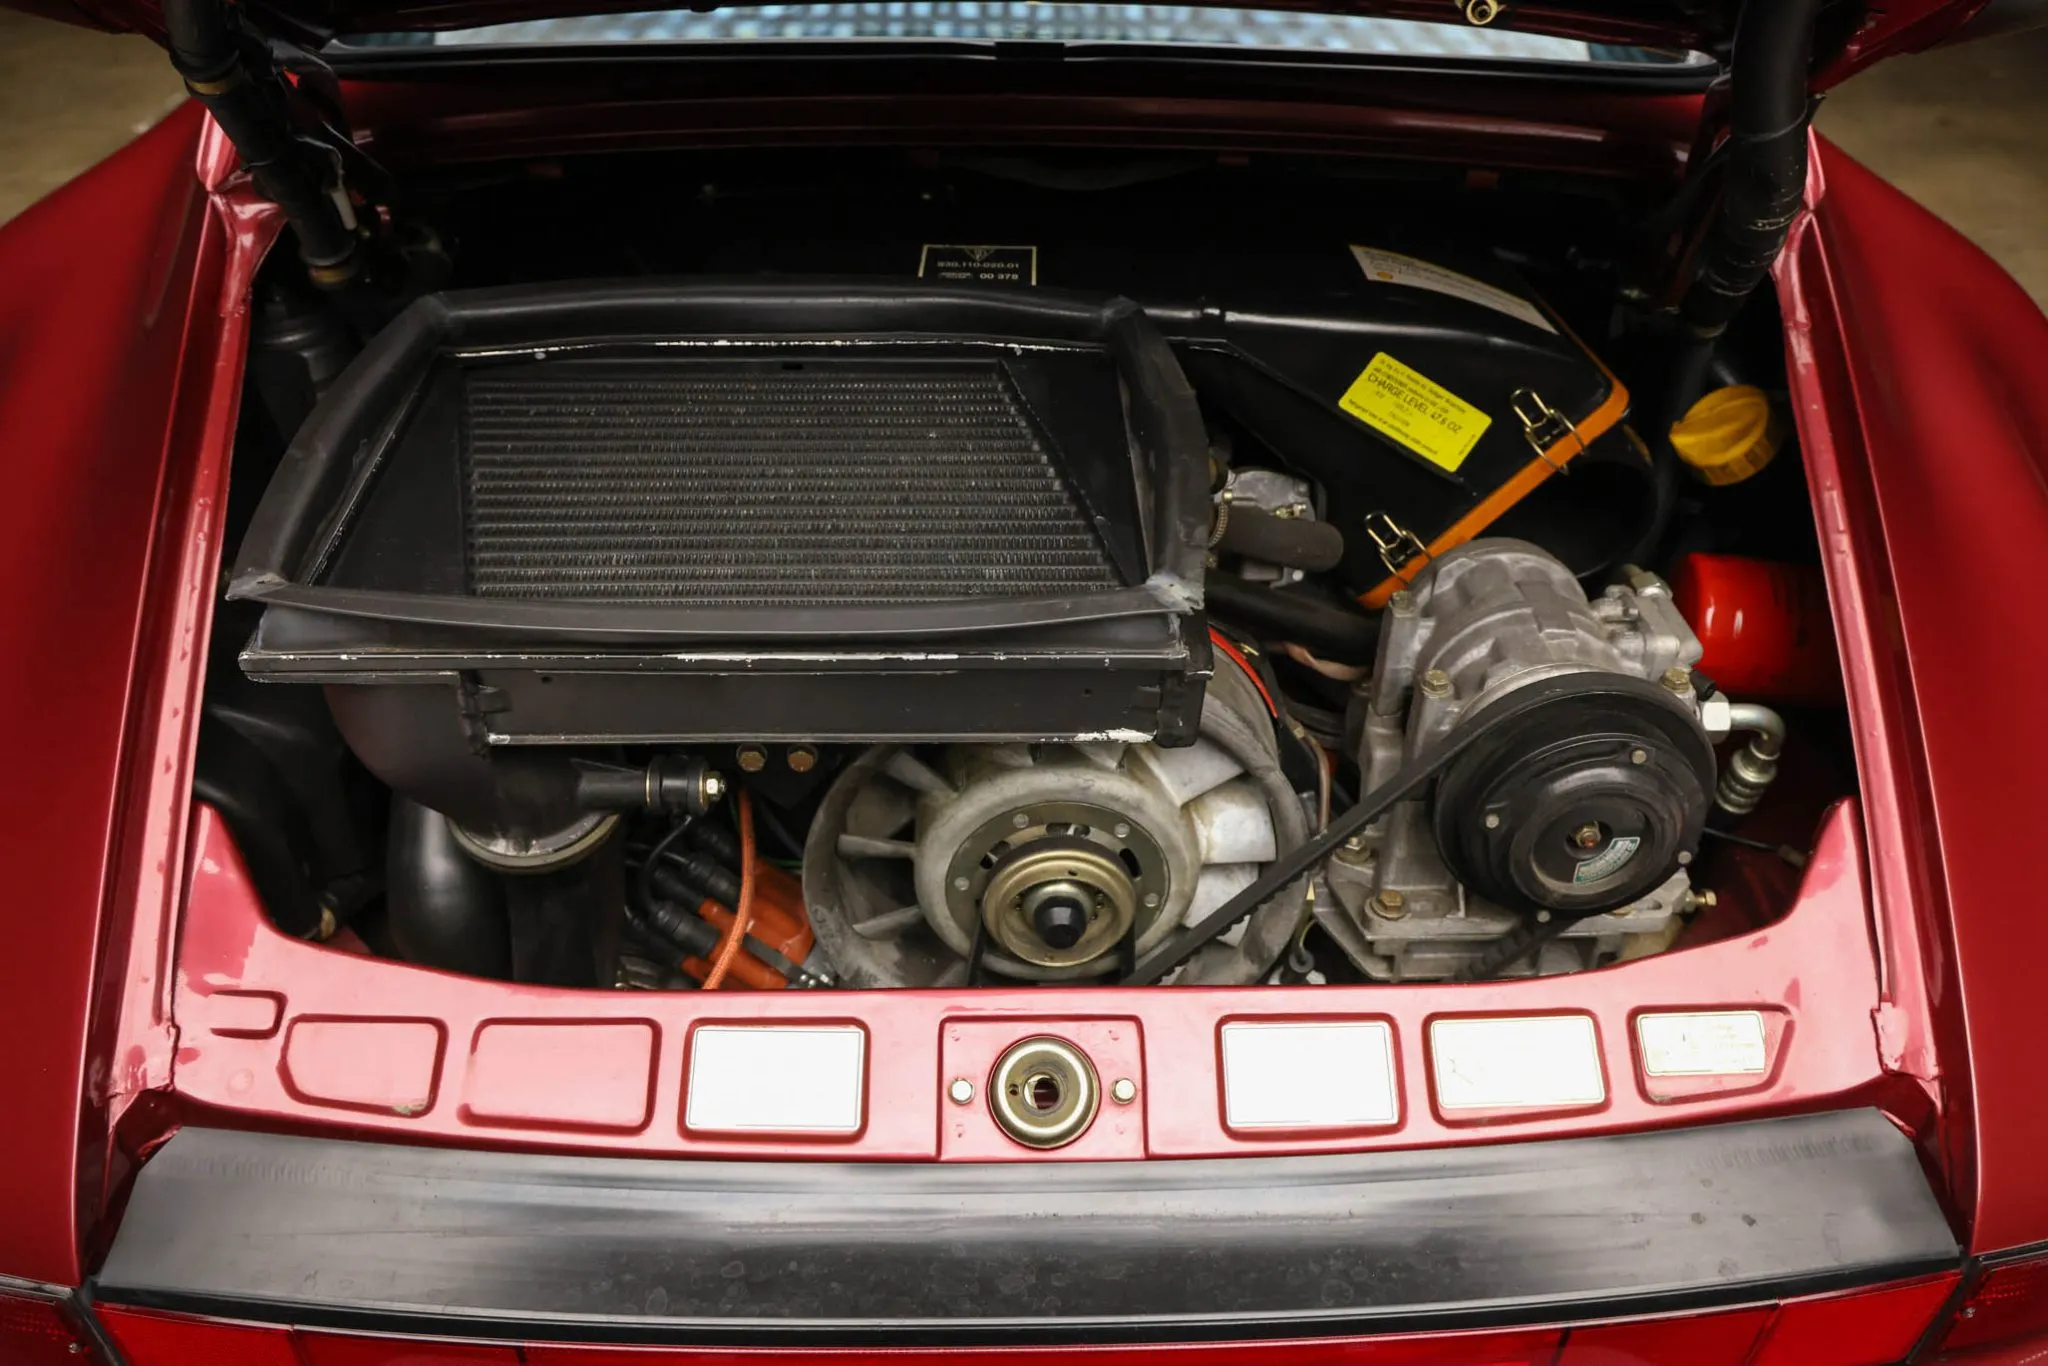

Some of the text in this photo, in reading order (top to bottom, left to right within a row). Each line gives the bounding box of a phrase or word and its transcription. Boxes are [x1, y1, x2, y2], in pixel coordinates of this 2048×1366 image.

[1368, 372, 1405, 399] CHARGE
[1403, 394, 1429, 415] LEVEL
[1447, 420, 1463, 433] OZ
